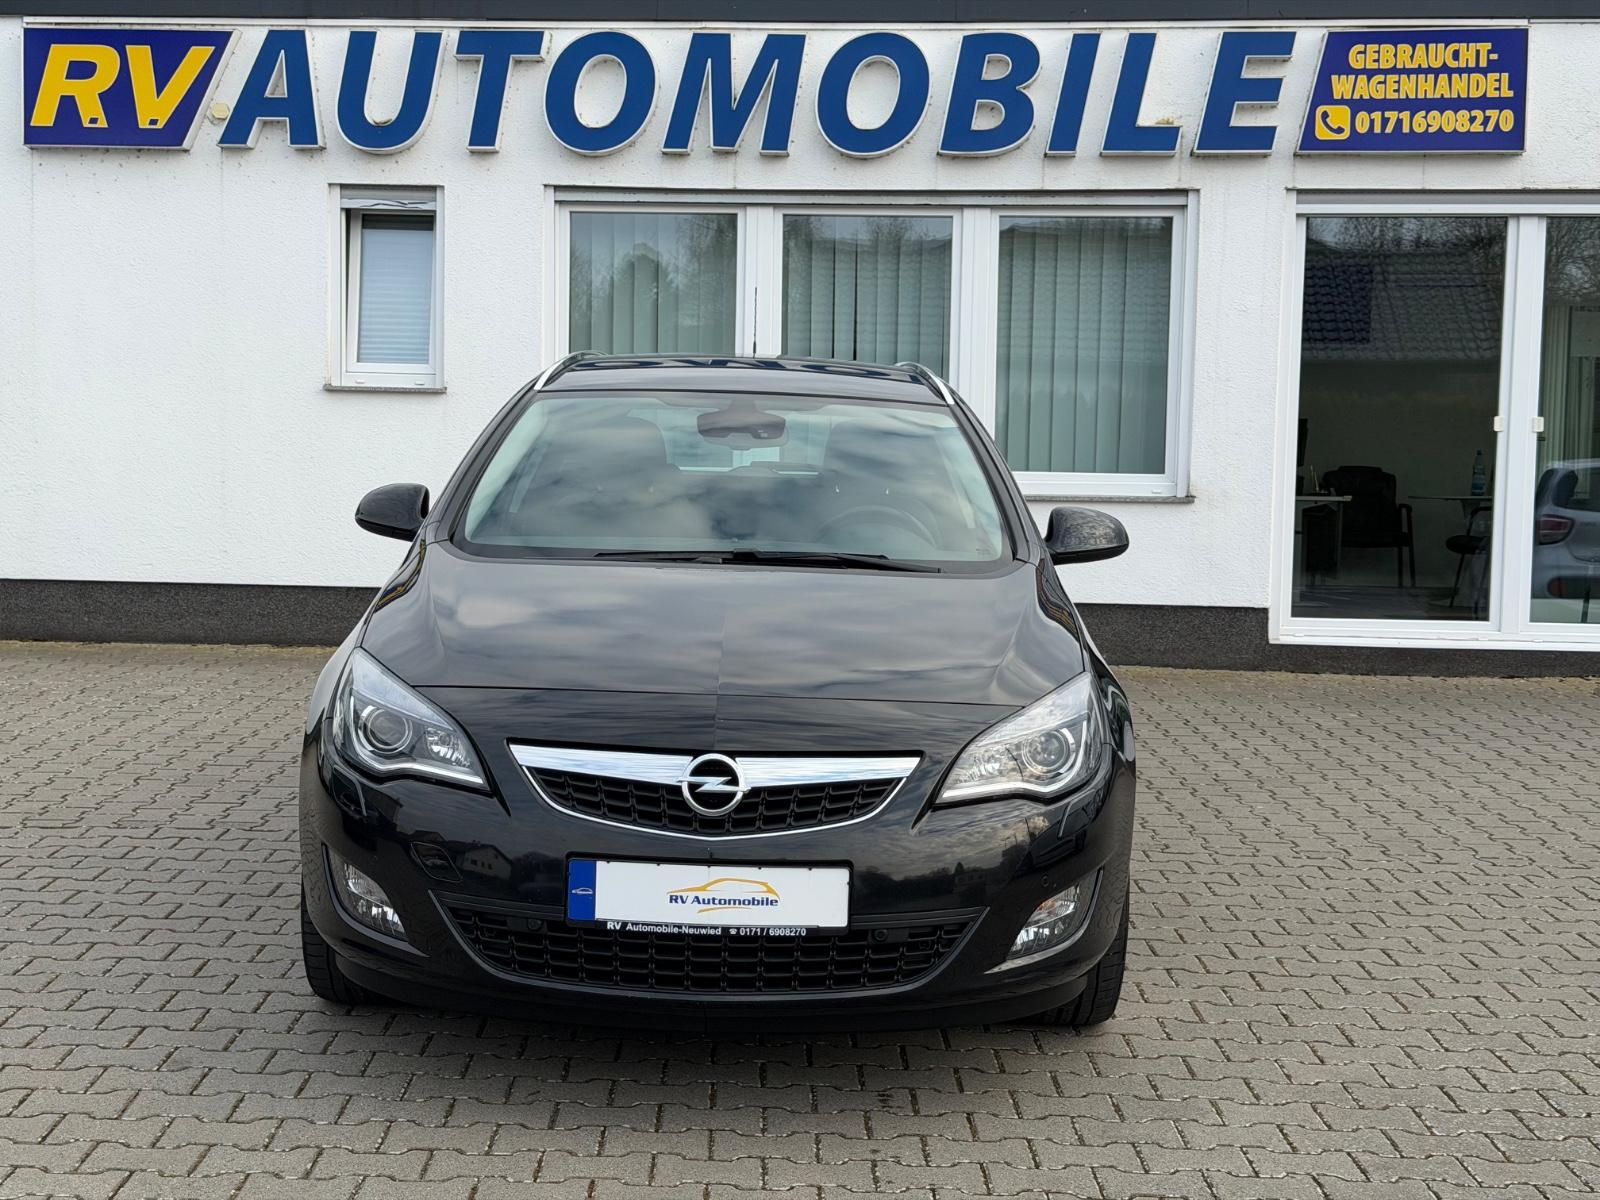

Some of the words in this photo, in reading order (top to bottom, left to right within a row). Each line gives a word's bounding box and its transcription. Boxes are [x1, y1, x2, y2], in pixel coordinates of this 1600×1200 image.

[1348, 42, 1499, 70] GEBRAUCHT-
[218, 29, 1296, 156] AUTOMOBILE
[1331, 72, 1514, 100] WAGENHANDEL
[1355, 109, 1515, 134] 01716908270
[669, 895, 688, 905] RV
[691, 895, 779, 907] Automobile
[607, 921, 621, 931] RV
[626, 922, 722, 936] Automobile-Neuwied
[739, 927, 761, 937] 0171
[769, 927, 807, 937] 6908270
